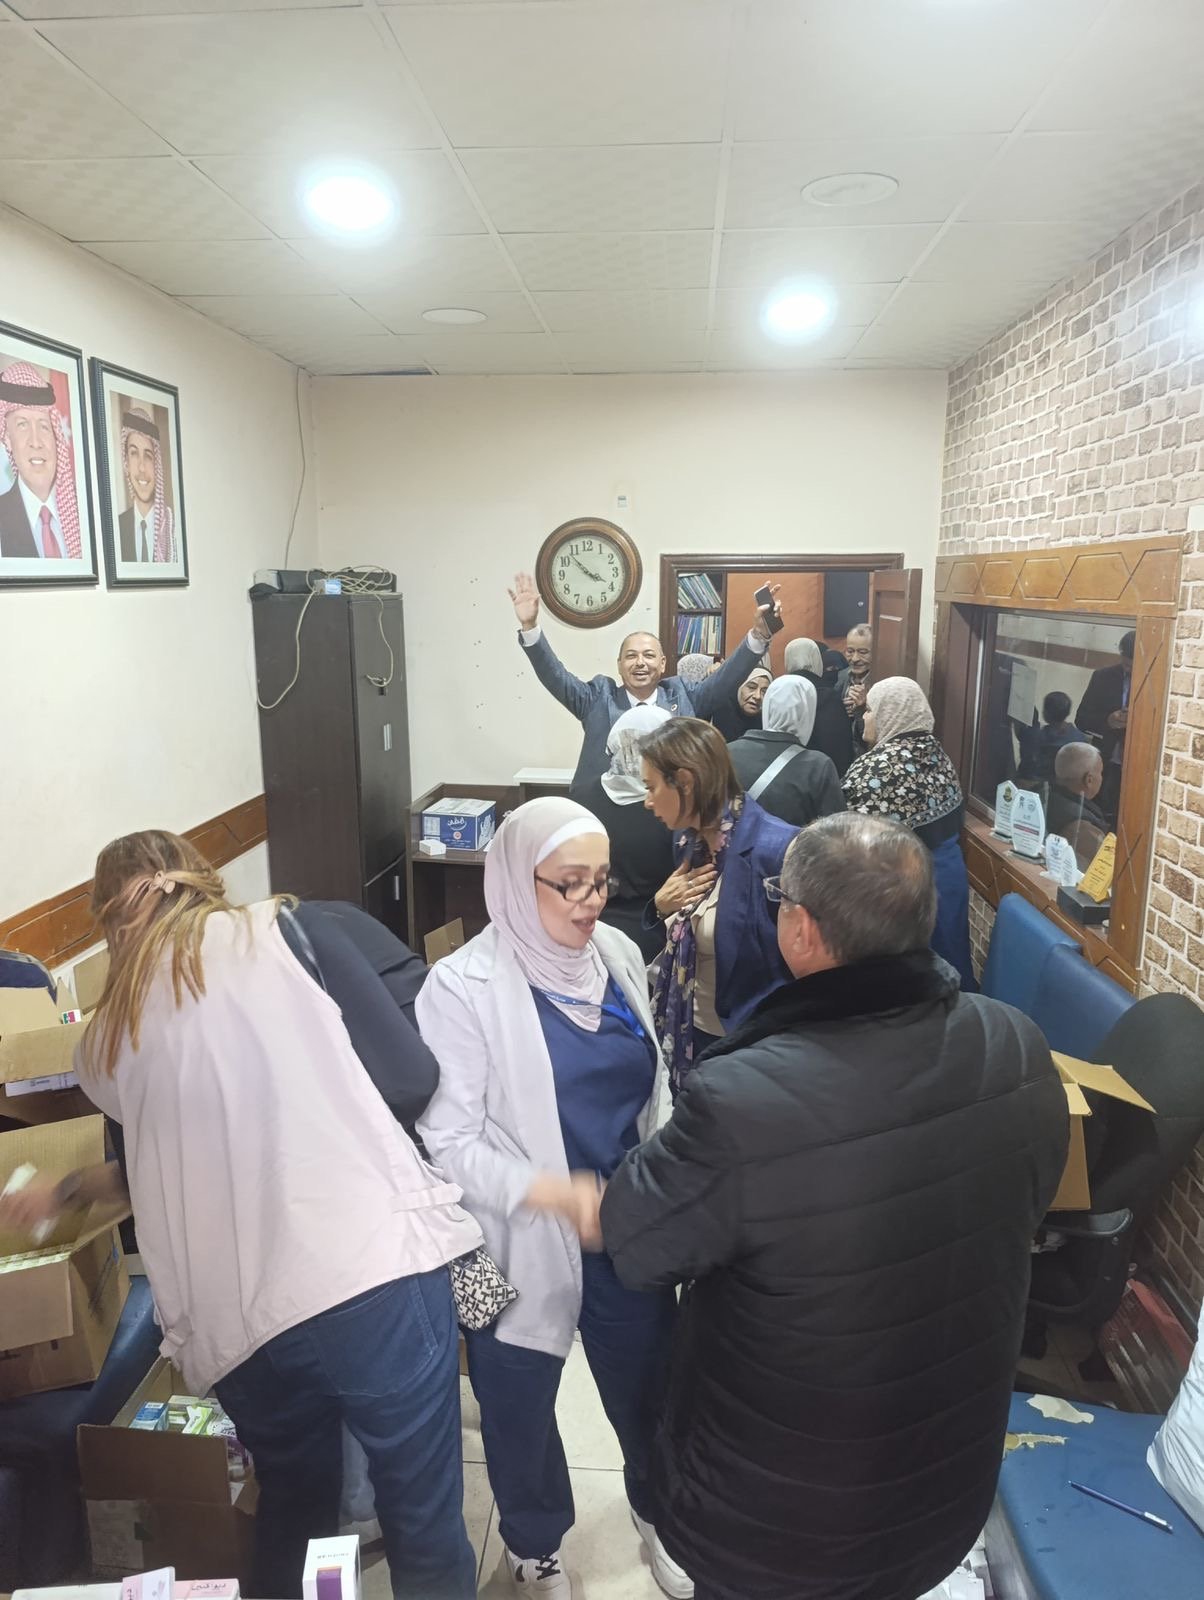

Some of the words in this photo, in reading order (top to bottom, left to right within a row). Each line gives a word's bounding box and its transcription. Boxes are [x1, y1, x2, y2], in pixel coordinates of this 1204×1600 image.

[570, 544, 579, 556] 11
[582, 540, 593, 552] 12
[598, 544, 602, 554] 1
[560, 556, 570, 567] 10
[608, 553, 614, 565] 2
[558, 570, 566, 580] 9
[612, 567, 618, 578] 3
[564, 584, 570, 594] 8
[608, 582, 615, 592] 4
[574, 594, 580, 604] 7
[586, 596, 593, 606] 6
[600, 592, 606, 602] 5
